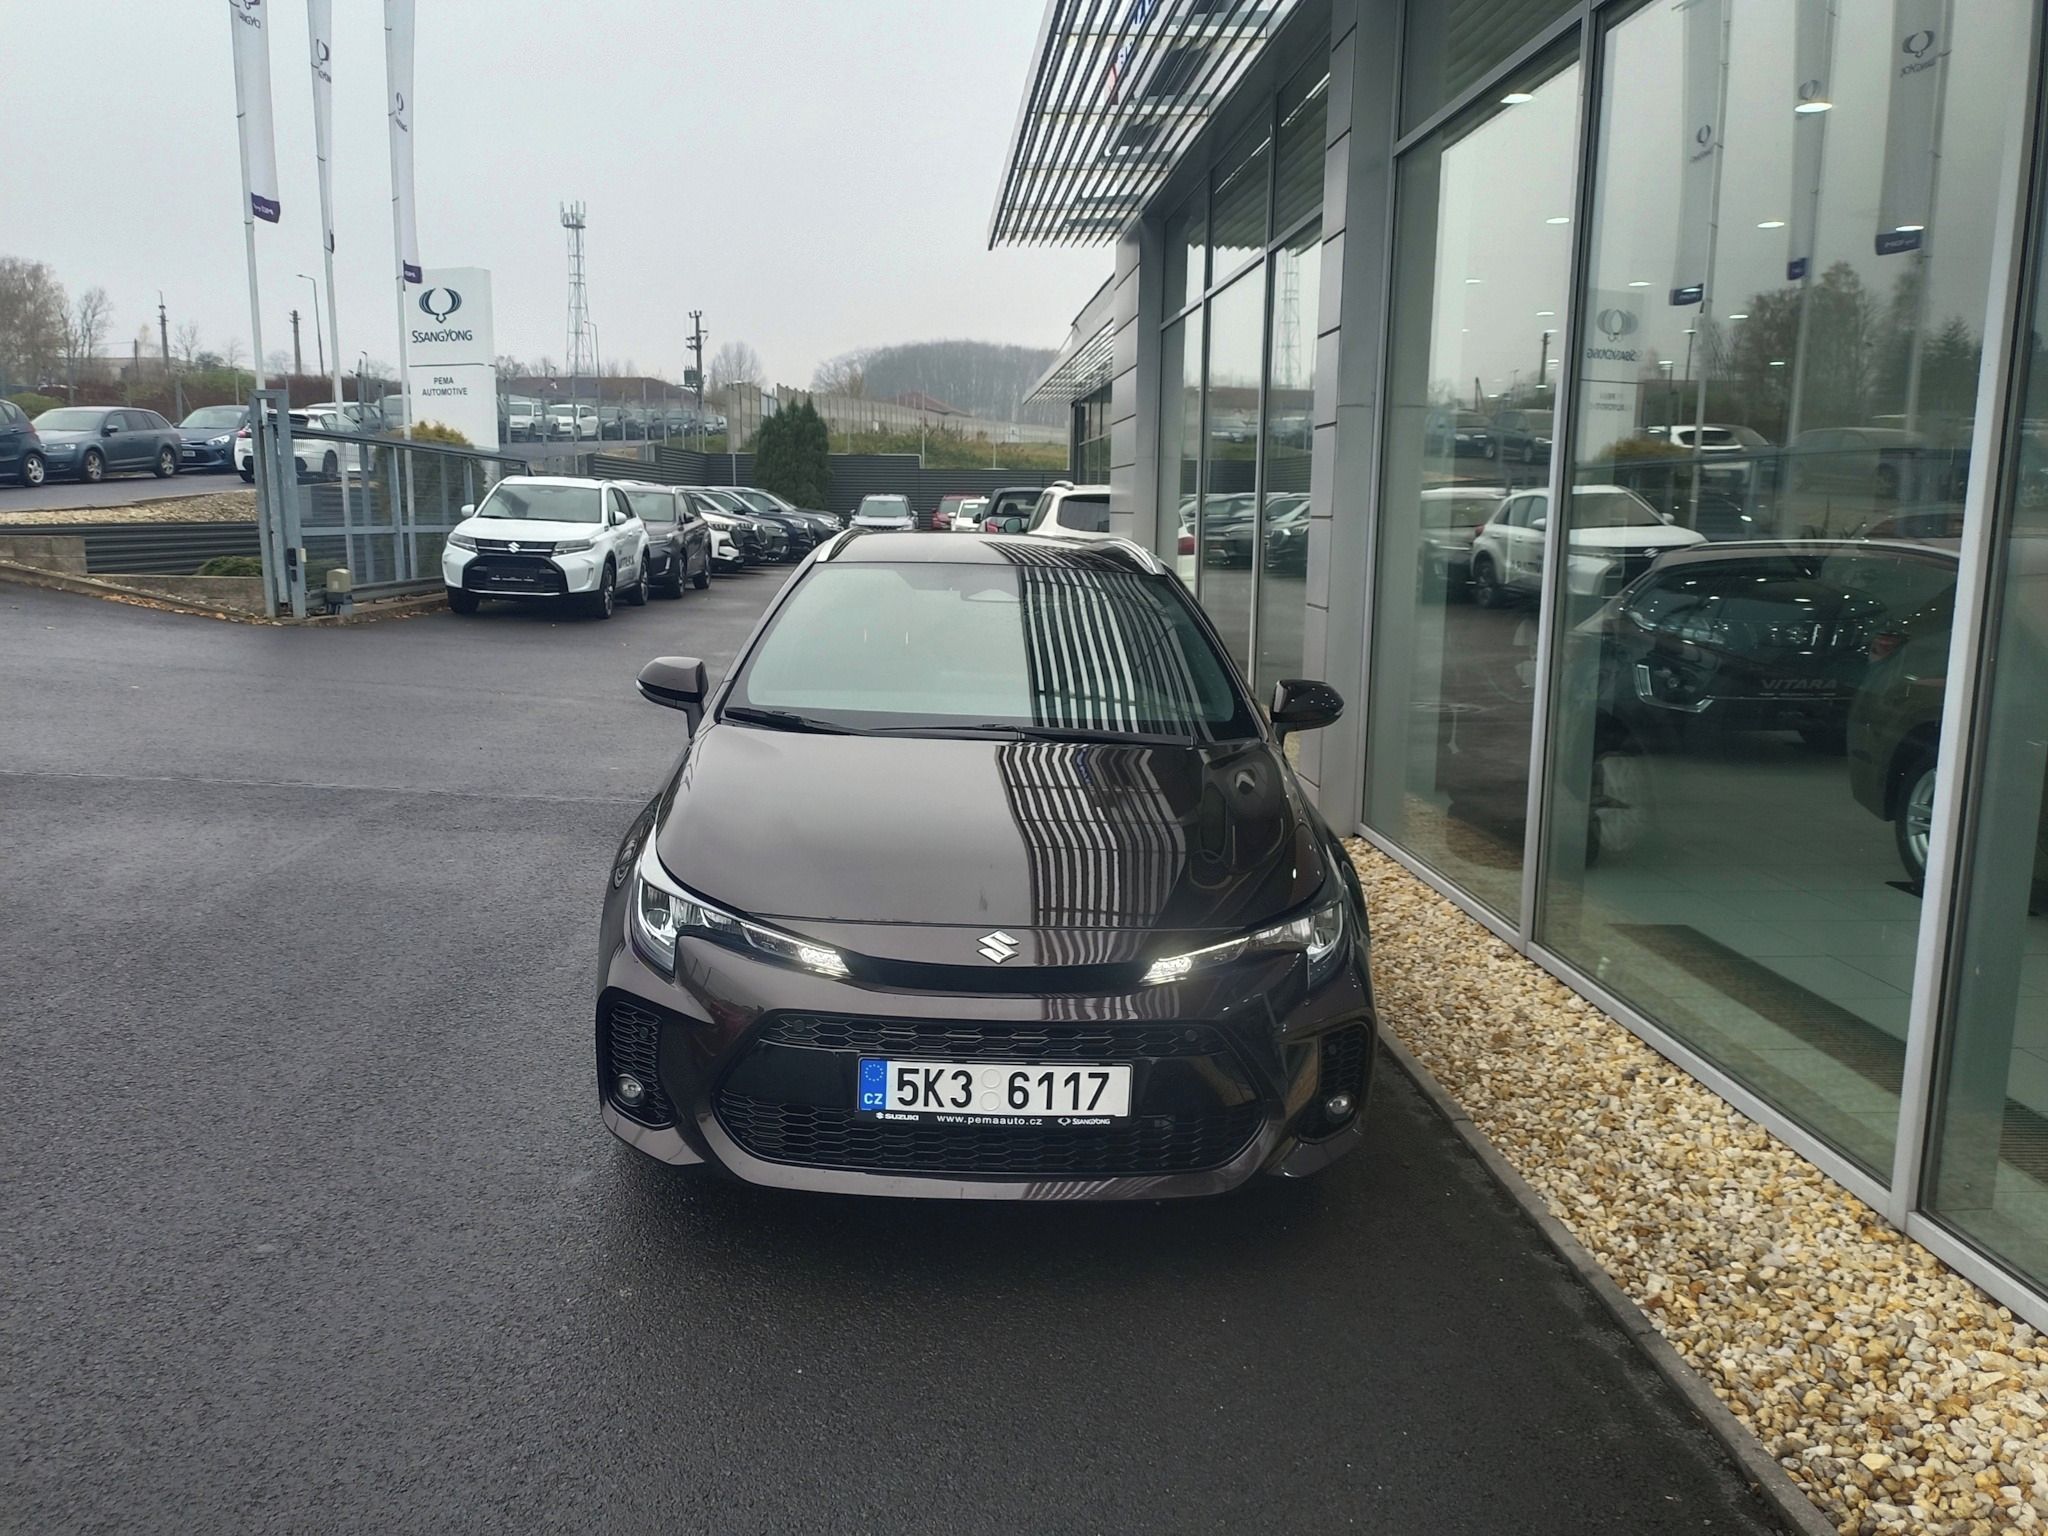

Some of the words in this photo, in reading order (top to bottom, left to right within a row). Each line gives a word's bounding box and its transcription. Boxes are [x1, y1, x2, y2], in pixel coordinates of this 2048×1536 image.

[412, 329, 473, 343] SSANGYONG
[433, 377, 454, 385] PEMA
[422, 387, 468, 396] AUTOMOTIVE
[1762, 679, 1837, 689] VITARA
[897, 1067, 973, 1108] 5K3
[1008, 1071, 1110, 1111] 6117
[863, 1093, 883, 1105] CZ
[885, 1113, 919, 1121] SUZUKI
[936, 1115, 1043, 1126] www.pemaauto.cz
